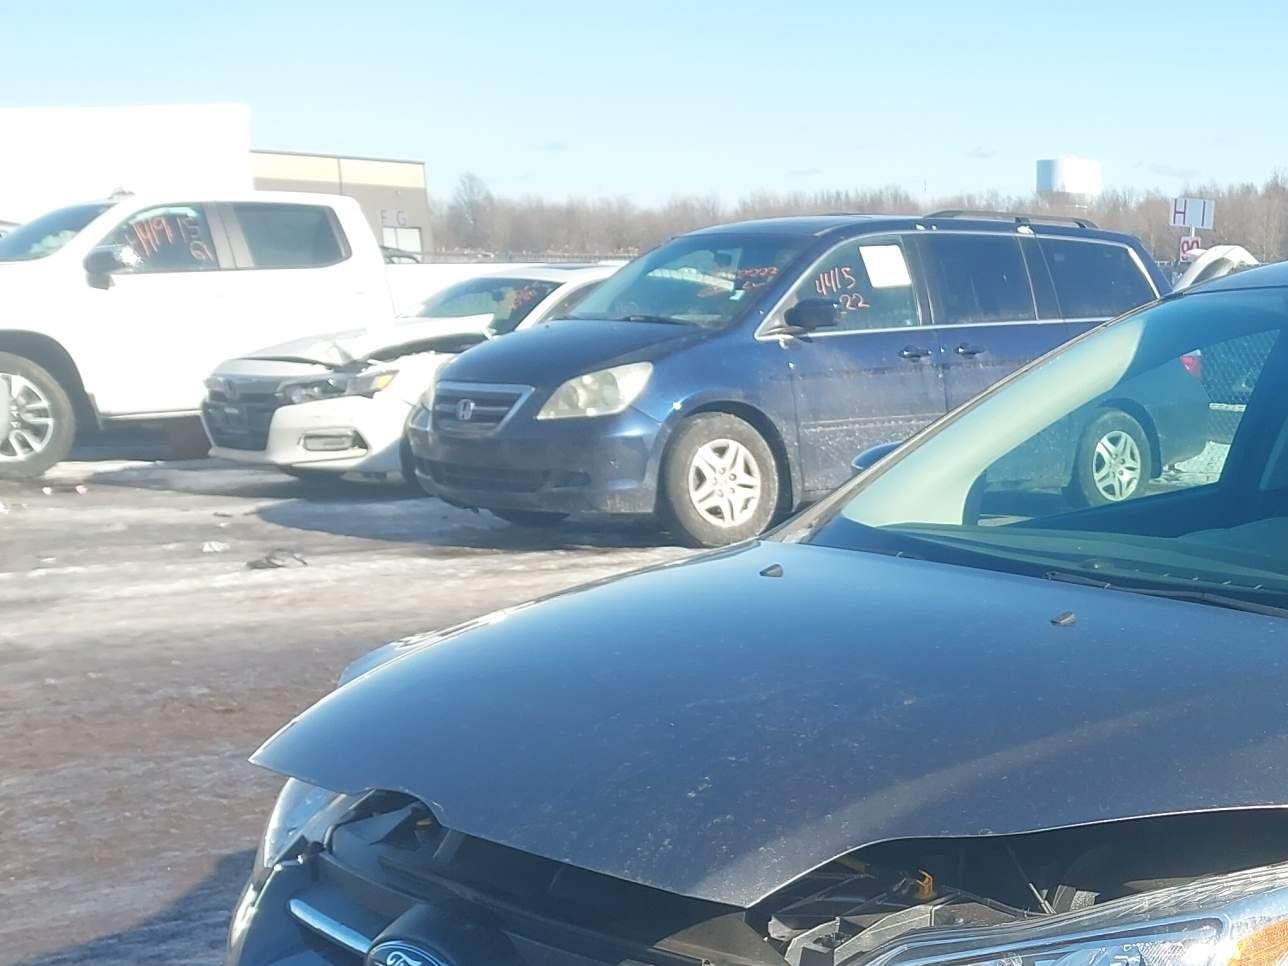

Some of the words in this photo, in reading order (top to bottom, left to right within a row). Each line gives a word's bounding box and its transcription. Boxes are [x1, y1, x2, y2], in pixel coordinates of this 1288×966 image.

[1172, 199, 1187, 225] H
[815, 267, 856, 296] 4415
[839, 292, 871, 311] 22
